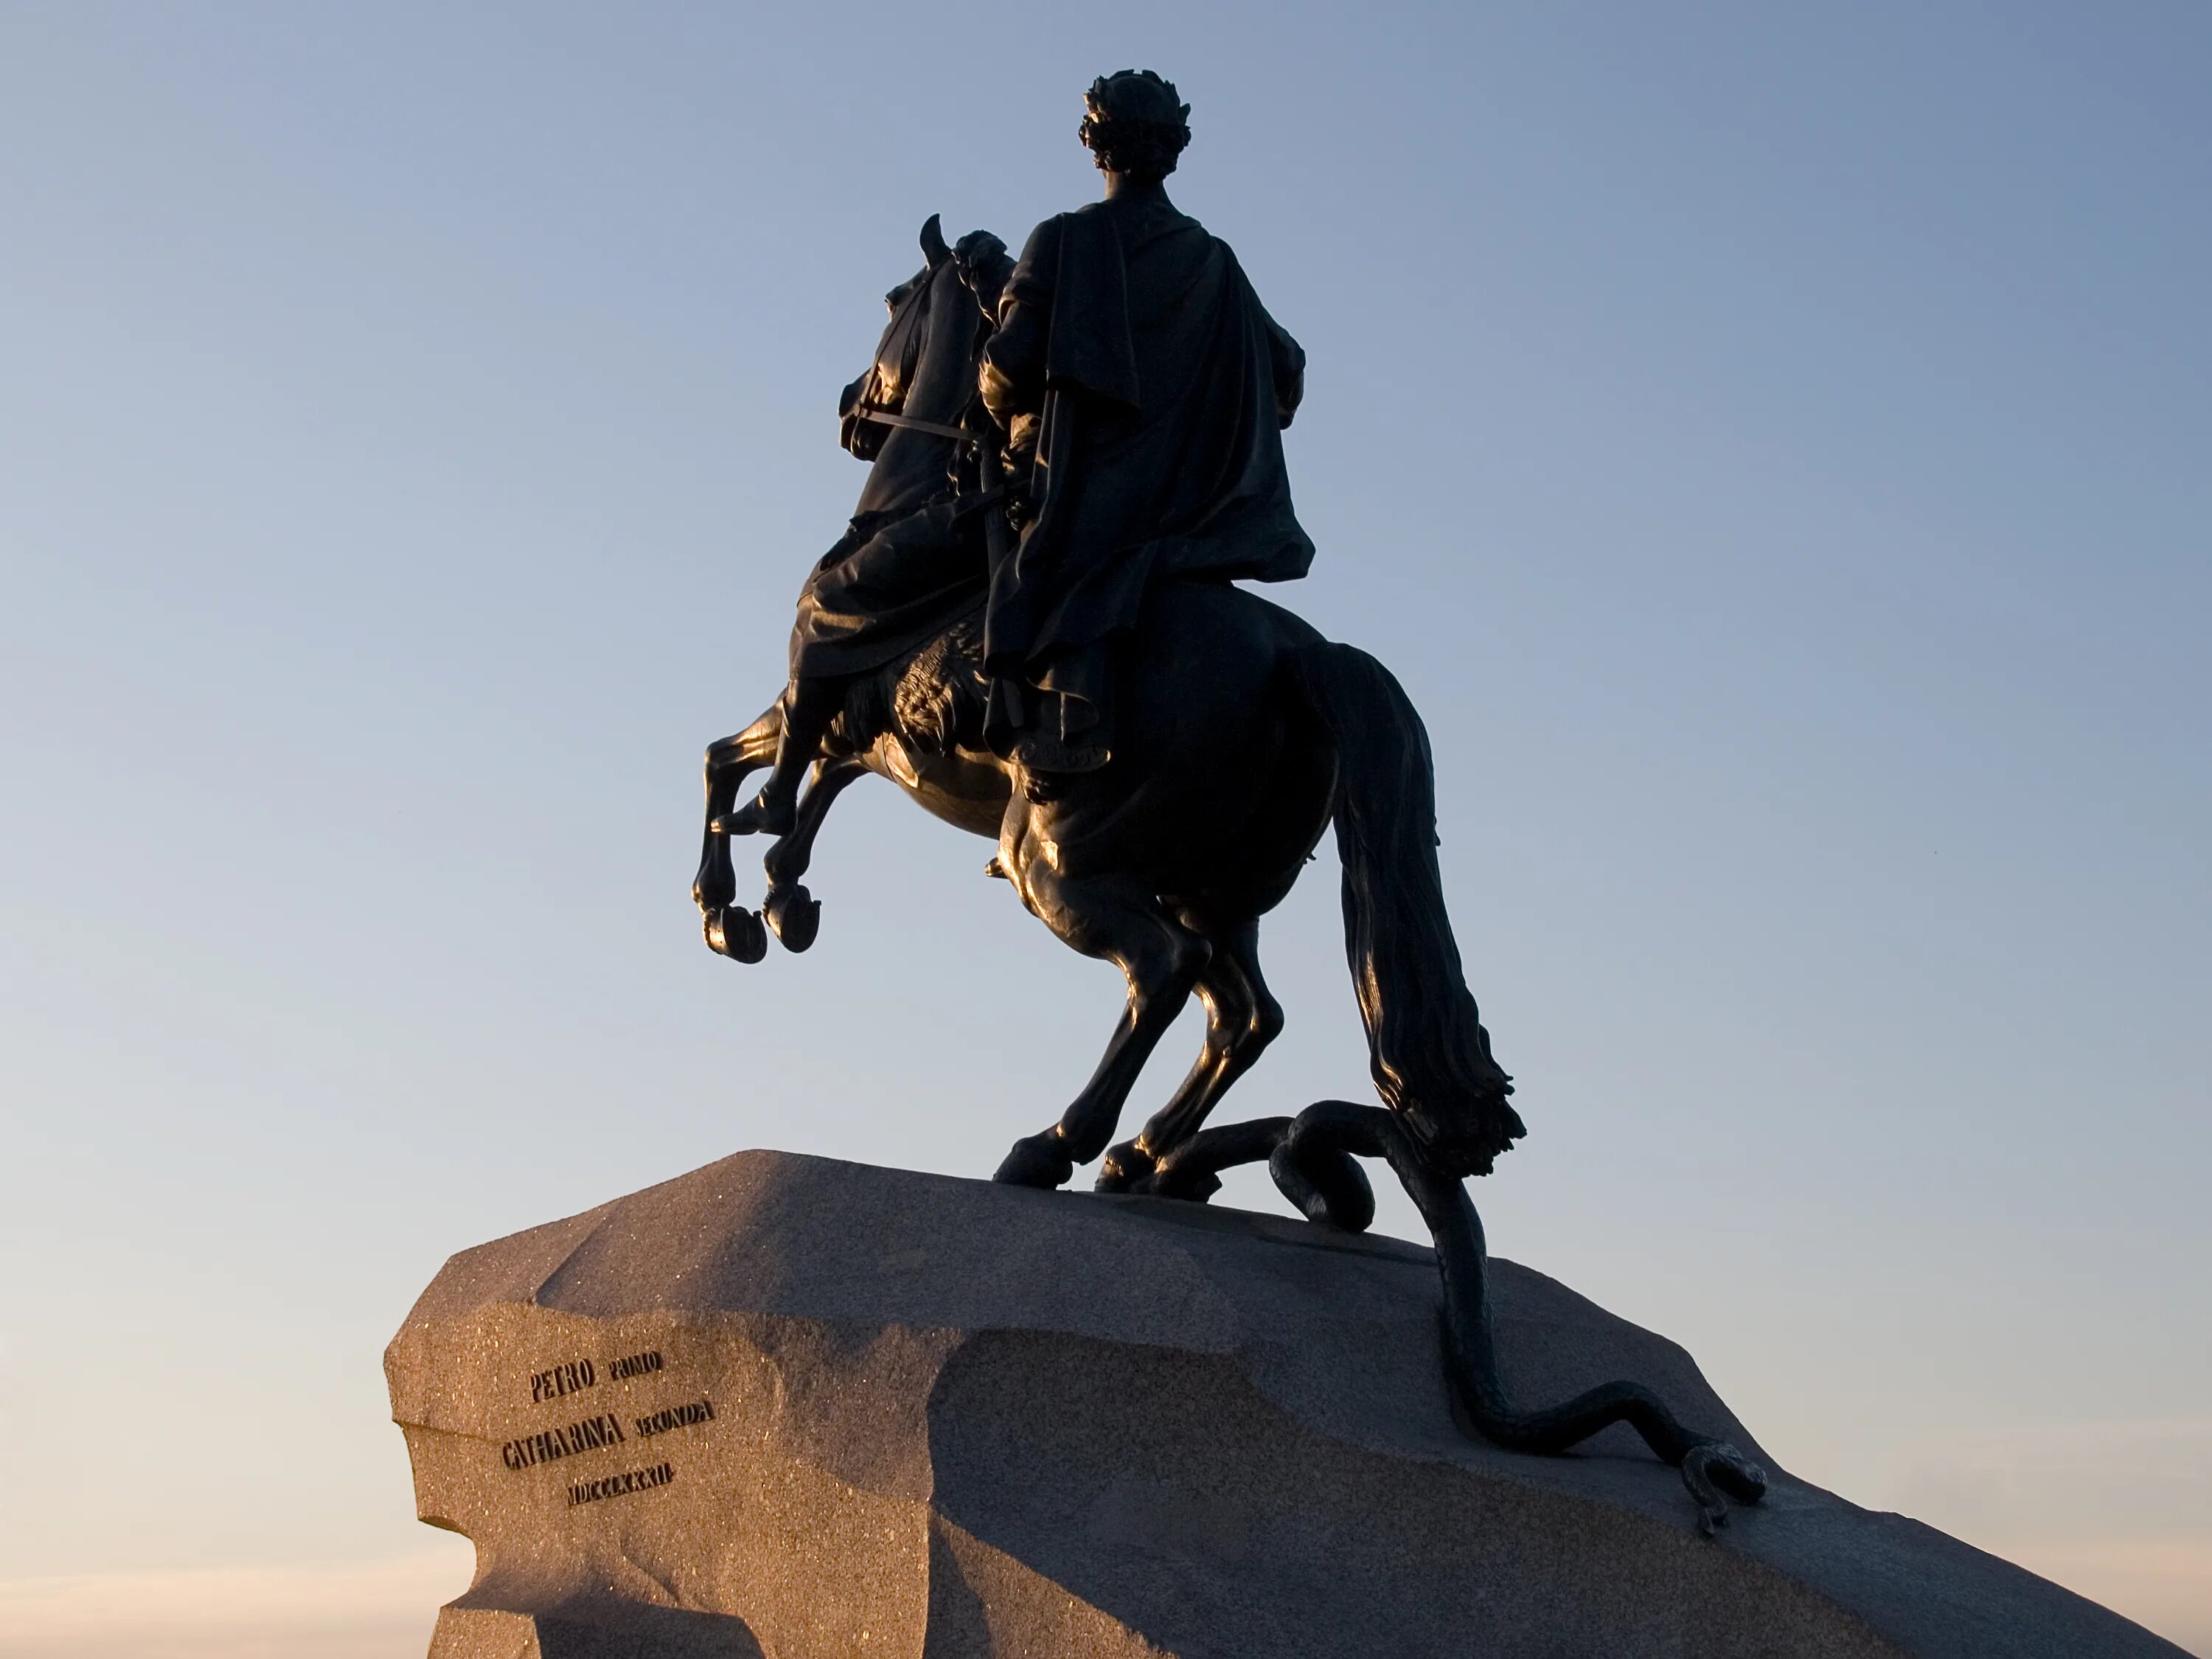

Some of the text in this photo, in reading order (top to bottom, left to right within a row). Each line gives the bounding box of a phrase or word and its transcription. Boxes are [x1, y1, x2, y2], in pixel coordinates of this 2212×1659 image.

[531, 1351, 663, 1402] PETRO PRIMO
[503, 1401, 715, 1470] CATHARINA SECUNDA
